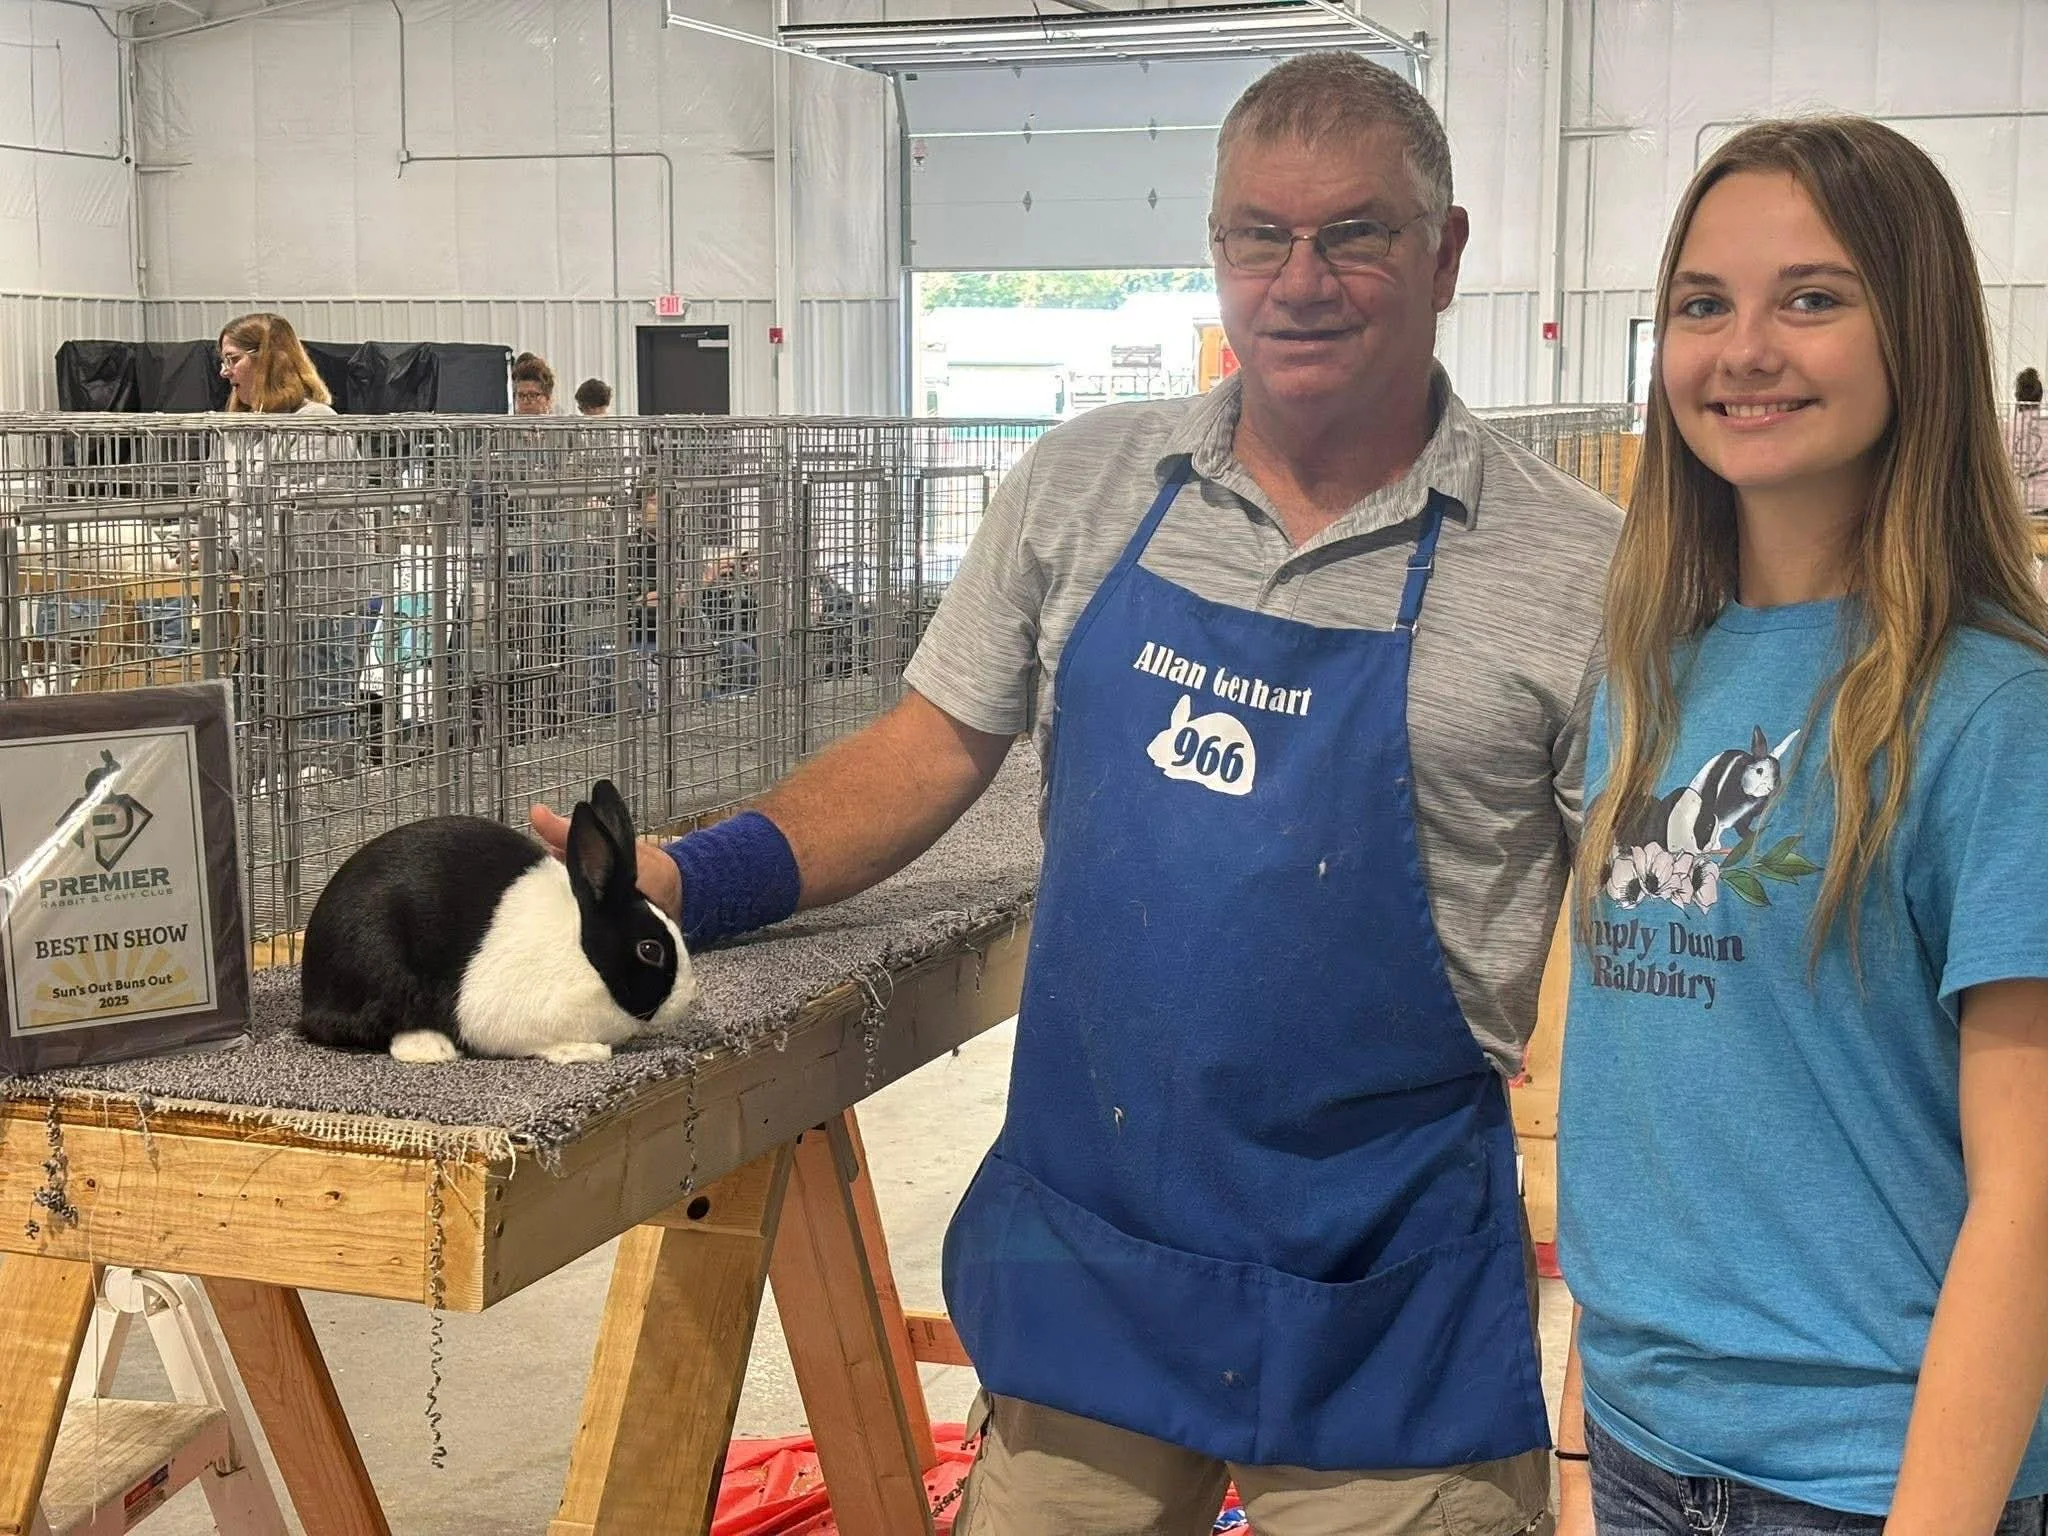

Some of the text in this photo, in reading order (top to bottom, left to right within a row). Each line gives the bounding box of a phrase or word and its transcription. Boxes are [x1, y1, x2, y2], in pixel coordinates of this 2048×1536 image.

[659, 296, 679, 313] EXIT
[1133, 641, 1312, 716] Allan Gerhart
[1171, 727, 1245, 783] 966
[39, 867, 170, 899] PREMIER
[35, 924, 189, 960] BEST IN SHOW
[1669, 922, 1745, 962] Dunn
[52, 974, 173, 1000] Sun's Out Buns Out
[1592, 954, 1716, 1010] Rabbitry
[99, 995, 130, 1009] 2025
